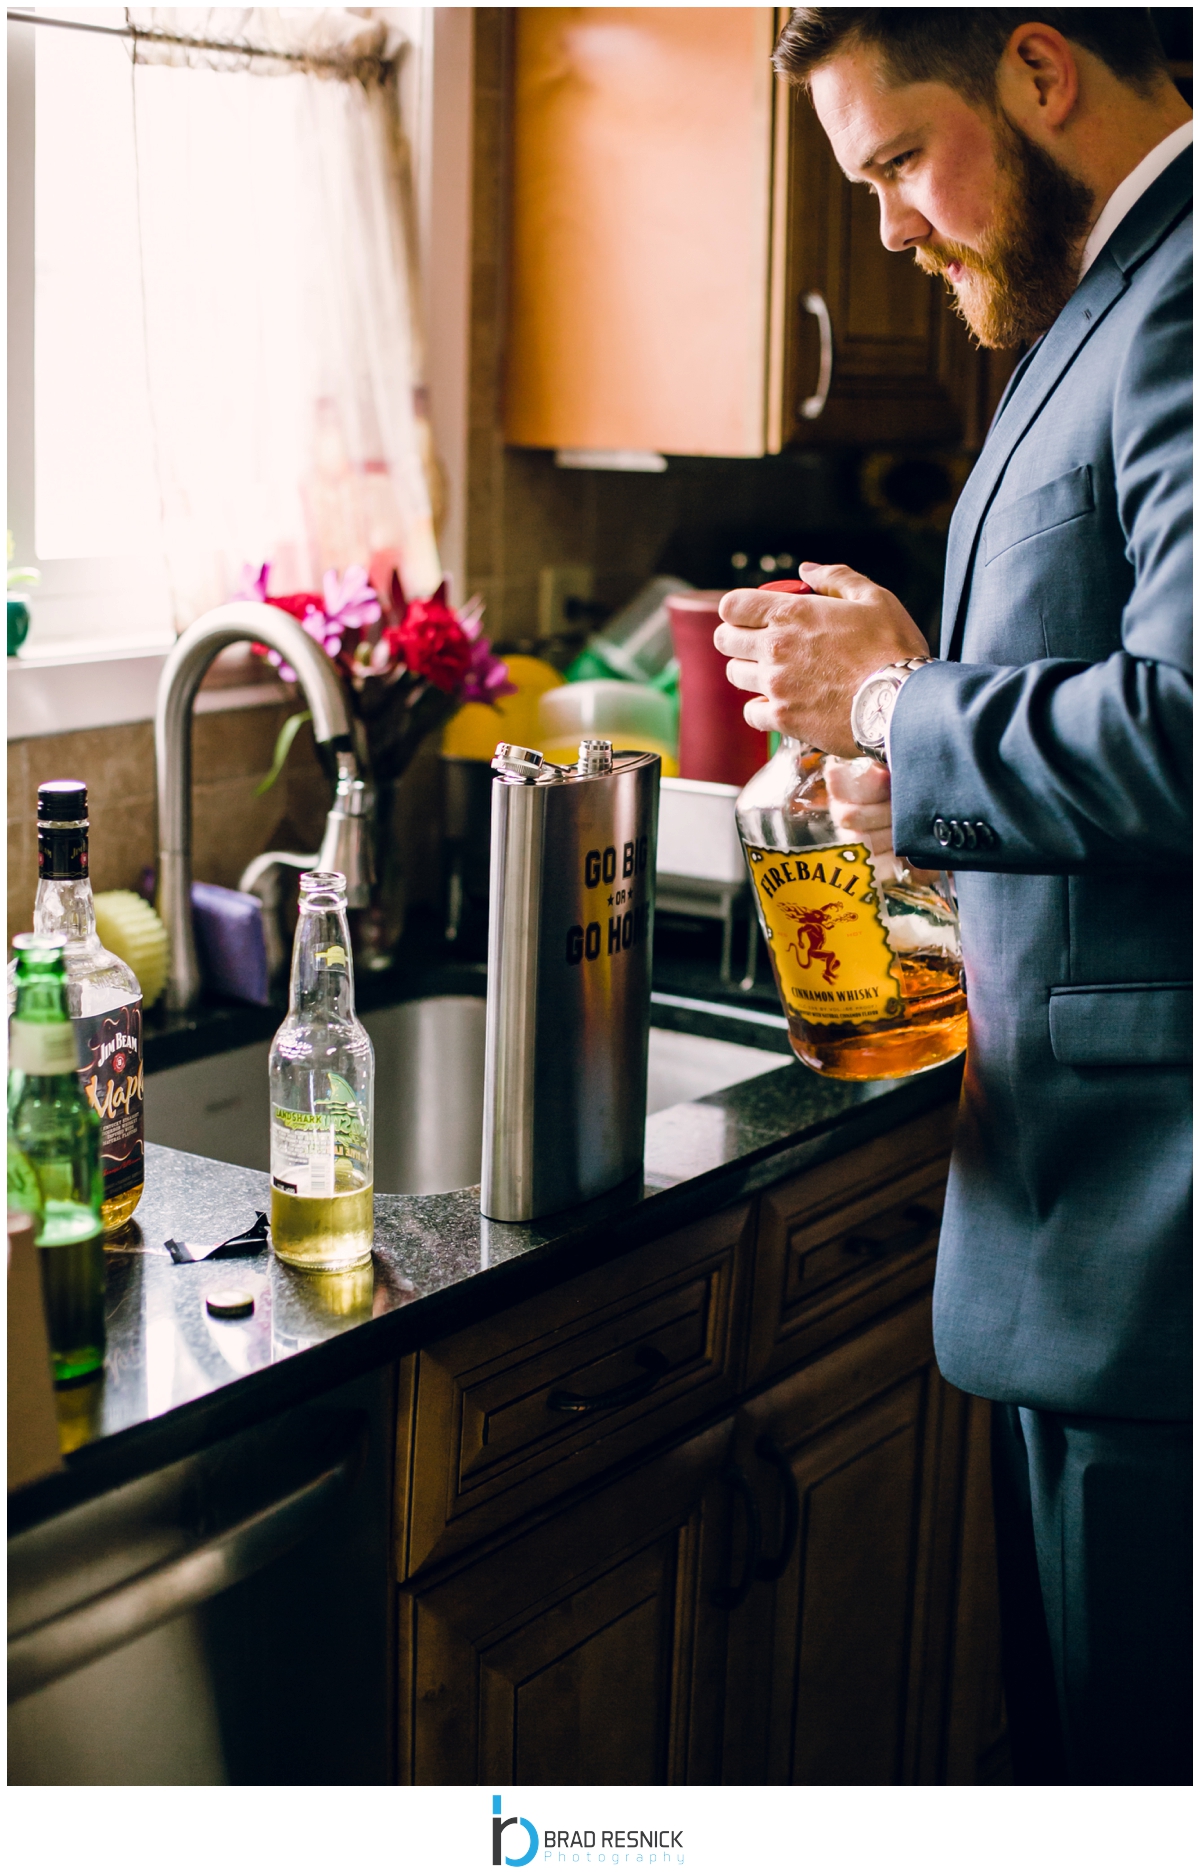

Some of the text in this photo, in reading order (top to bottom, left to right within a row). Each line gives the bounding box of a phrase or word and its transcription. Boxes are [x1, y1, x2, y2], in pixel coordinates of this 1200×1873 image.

[585, 835, 648, 889] GO BIG
[760, 860, 860, 899] FIREBALL
[615, 889, 626, 905] OR
[566, 921, 601, 967] GO
[791, 986, 879, 1003] CINNAMON WHISKY
[98, 1039, 115, 1067] JIM
[115, 1032, 138, 1053] BEAM
[84, 1059, 144, 1119] Mapl
